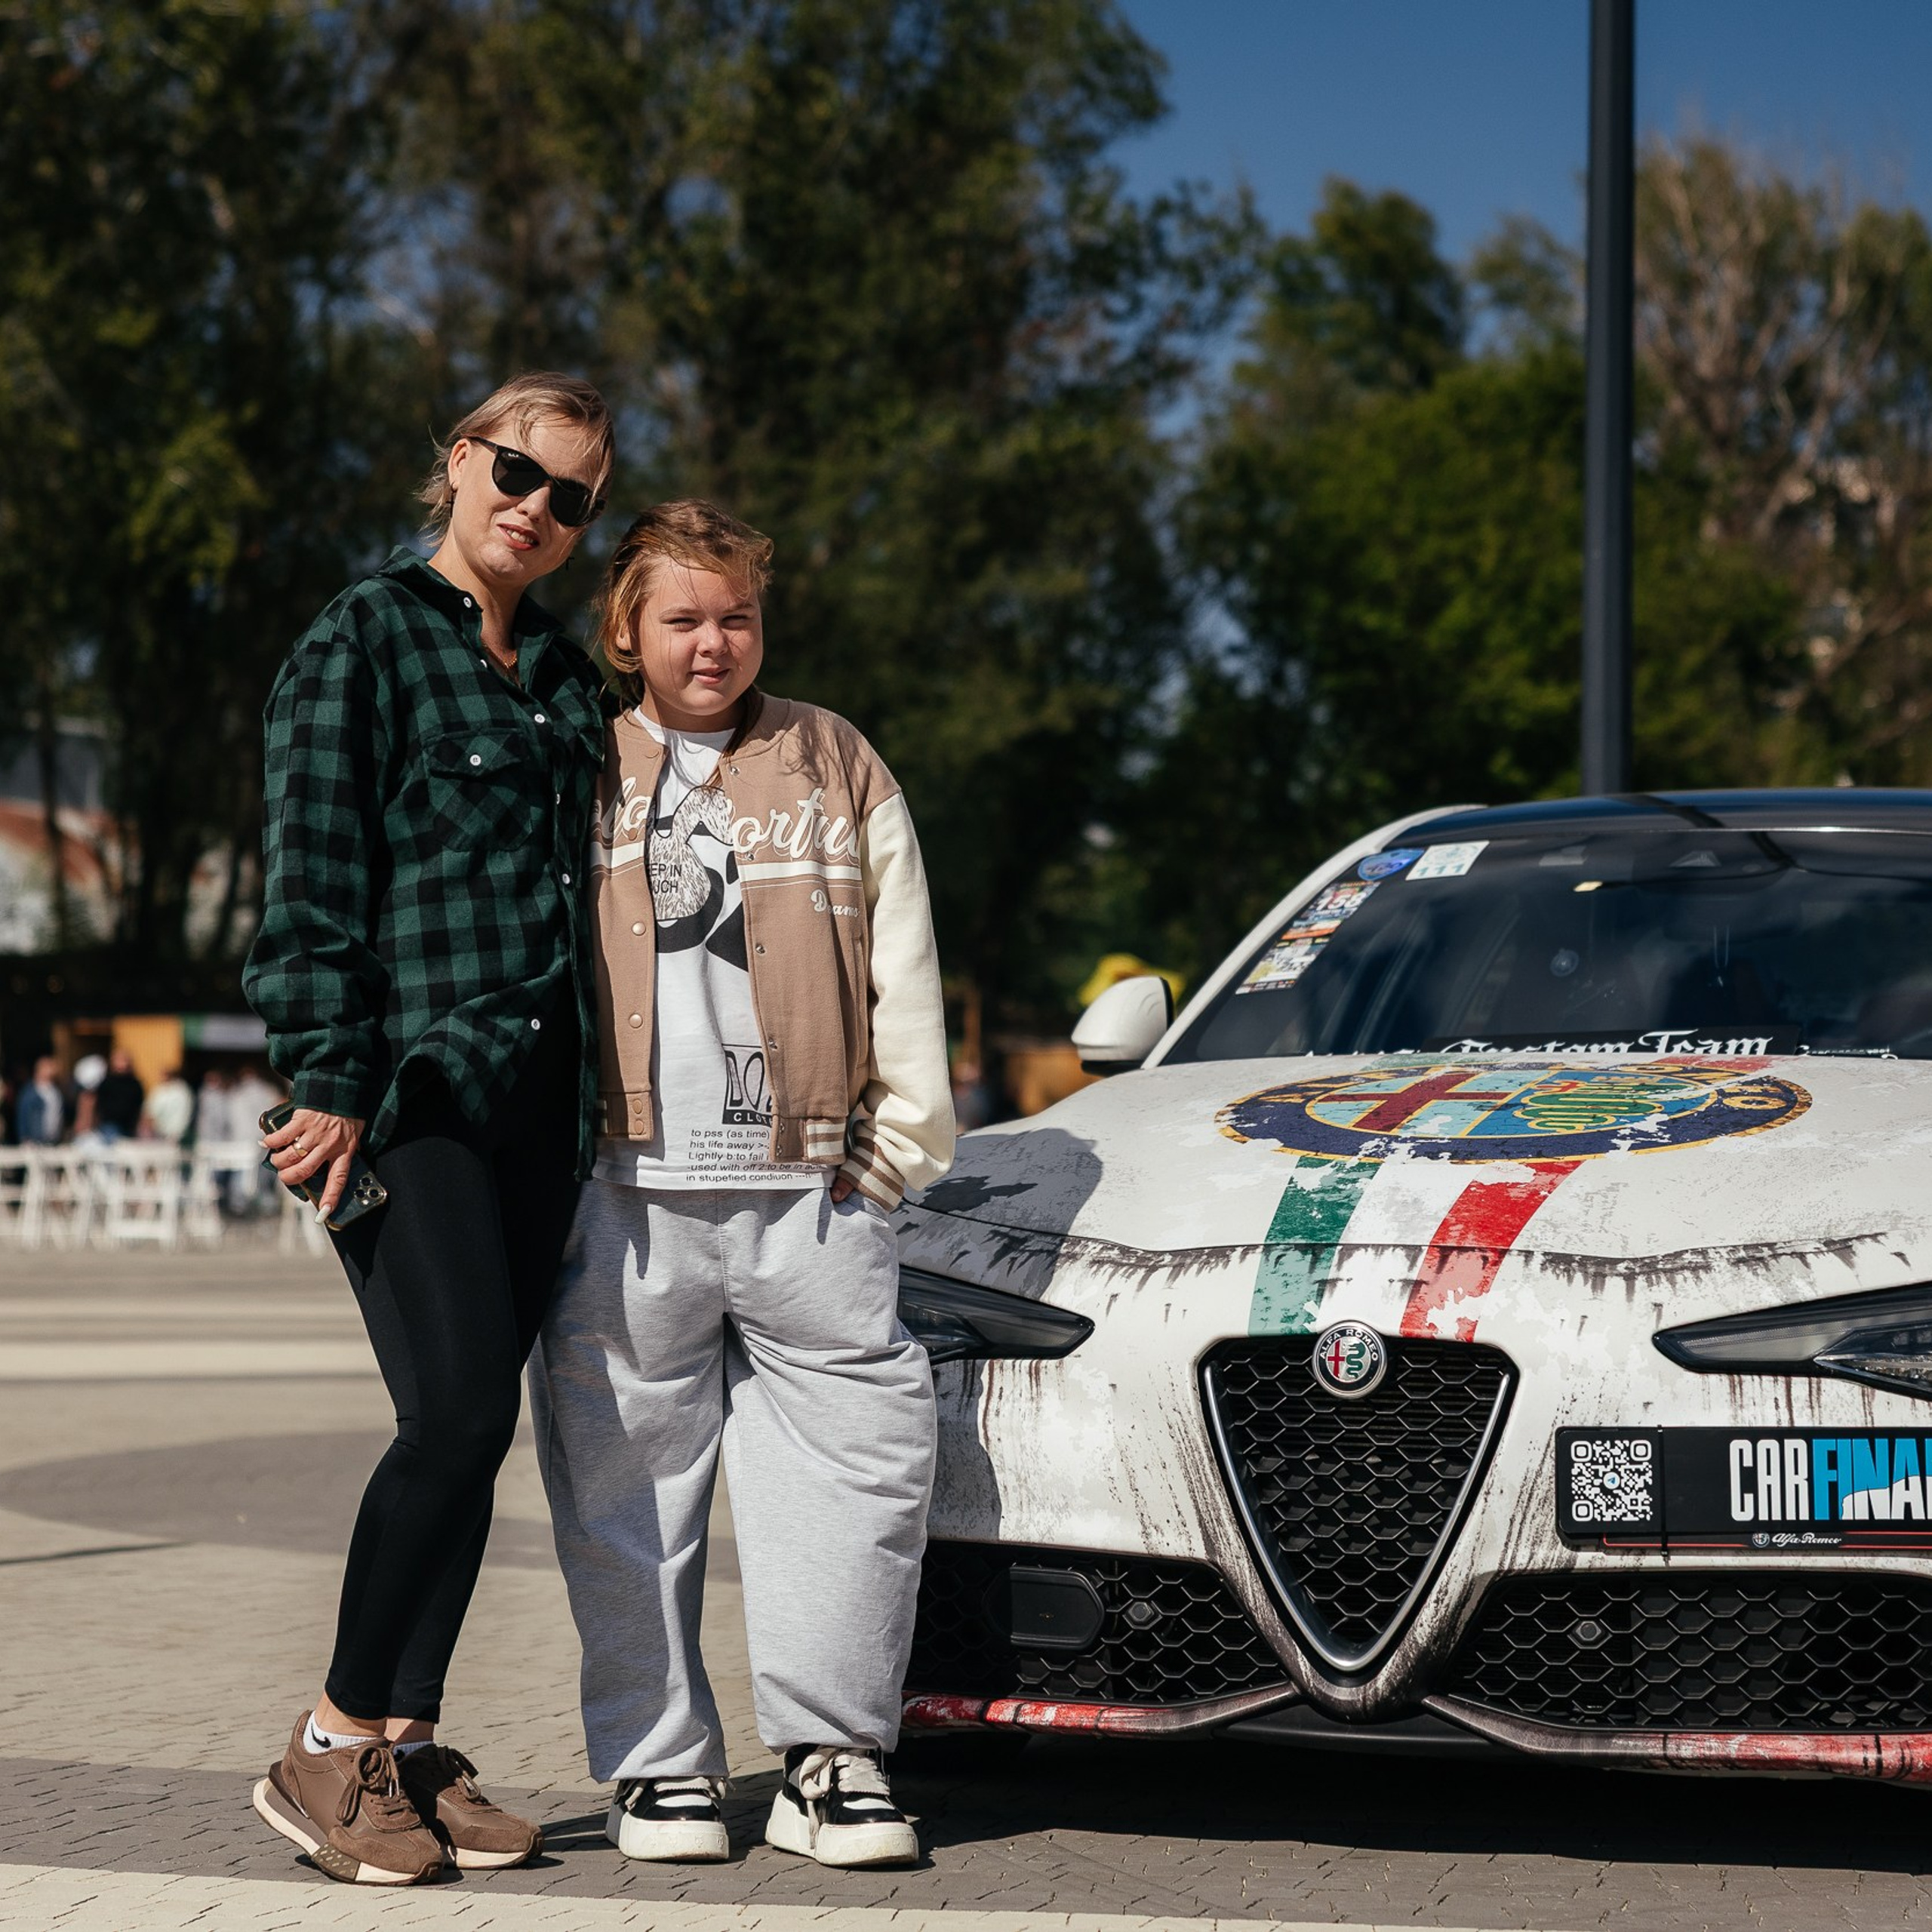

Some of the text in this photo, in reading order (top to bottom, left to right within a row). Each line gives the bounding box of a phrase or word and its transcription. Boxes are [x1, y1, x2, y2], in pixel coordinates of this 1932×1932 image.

[728, 787, 860, 860] ortu
[649, 863, 682, 877] EP IN
[654, 880, 678, 894] UCH
[1440, 1038, 1635, 1054] Ctom
[1638, 1029, 1774, 1055] Team
[724, 1051, 773, 1112] DO
[726, 1130, 743, 1139] (as
[746, 1130, 770, 1140] time)
[689, 1140, 705, 1149] his
[708, 1140, 724, 1149] life
[727, 1142, 755, 1151] away
[688, 1152, 723, 1162] Lightly
[749, 1152, 764, 1161] fail
[1319, 1329, 1379, 1361] ALFA ROMEO
